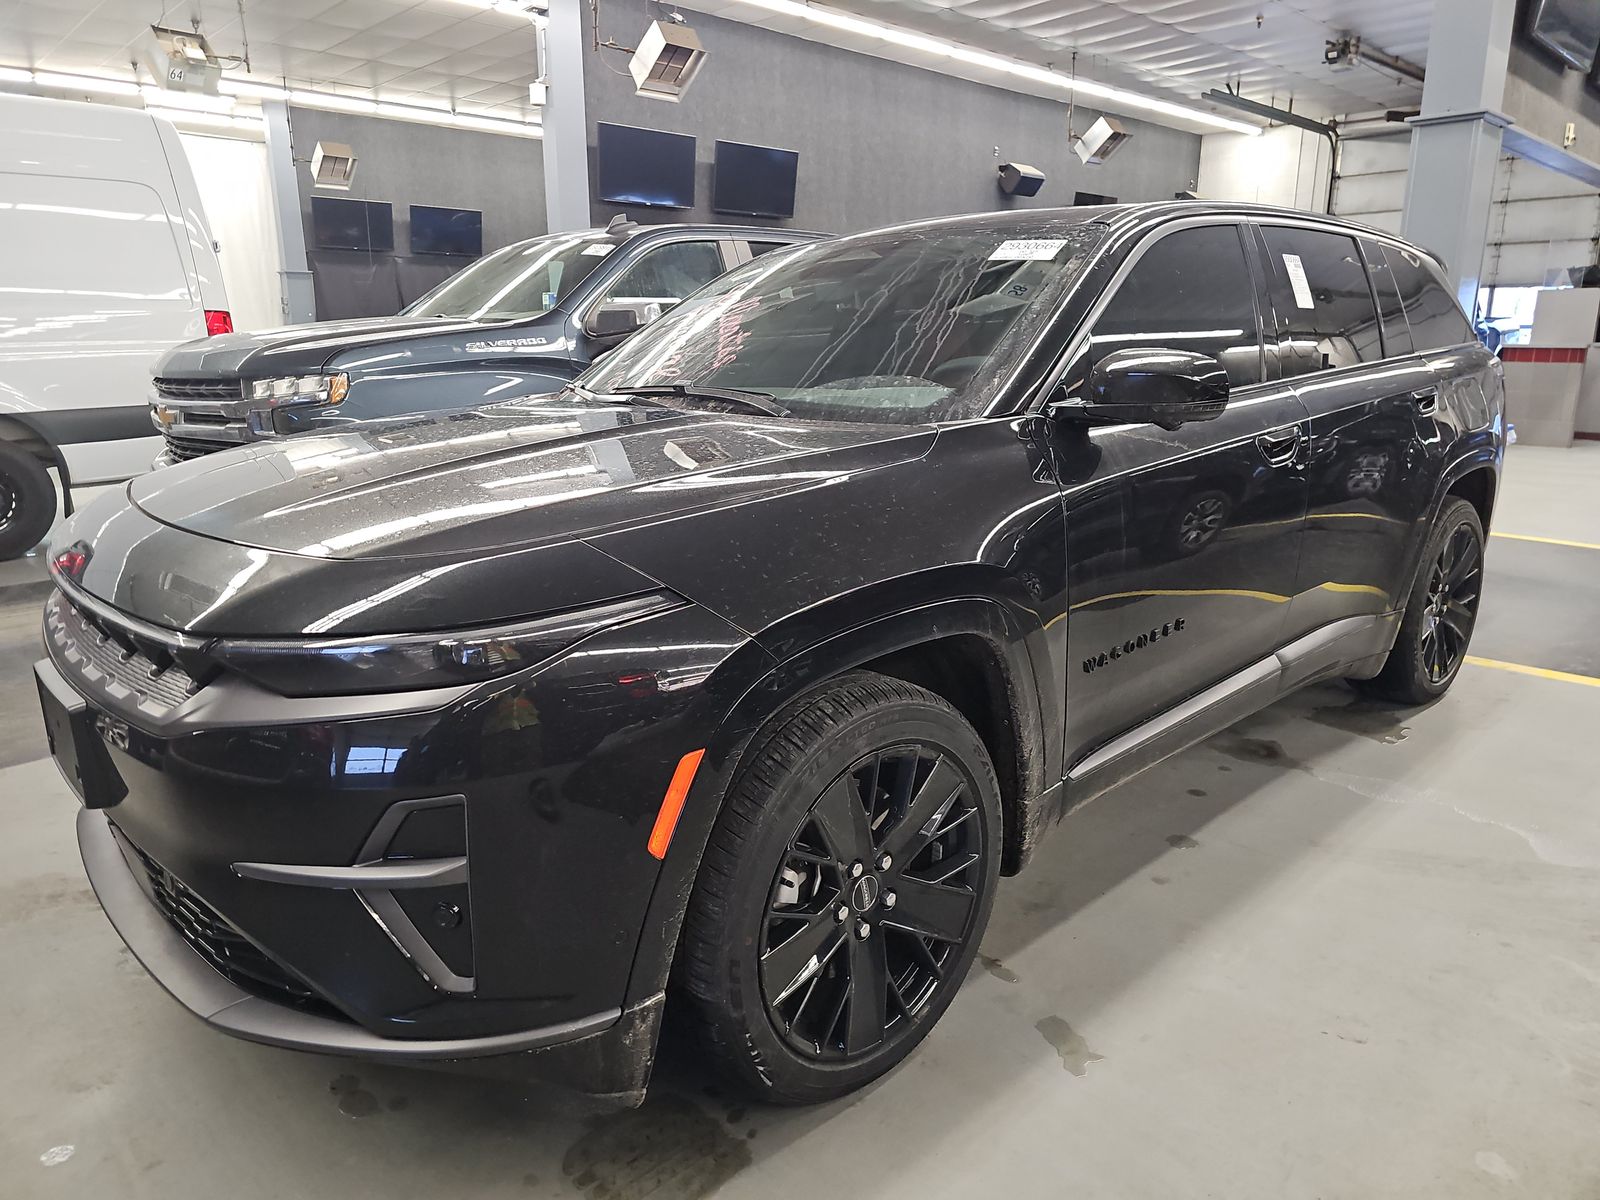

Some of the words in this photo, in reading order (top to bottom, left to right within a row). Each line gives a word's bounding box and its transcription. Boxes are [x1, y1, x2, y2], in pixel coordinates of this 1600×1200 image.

[169, 68, 184, 81] 64
[465, 337, 547, 351] SILVERADO
[1082, 617, 1185, 674] WAGONEER
